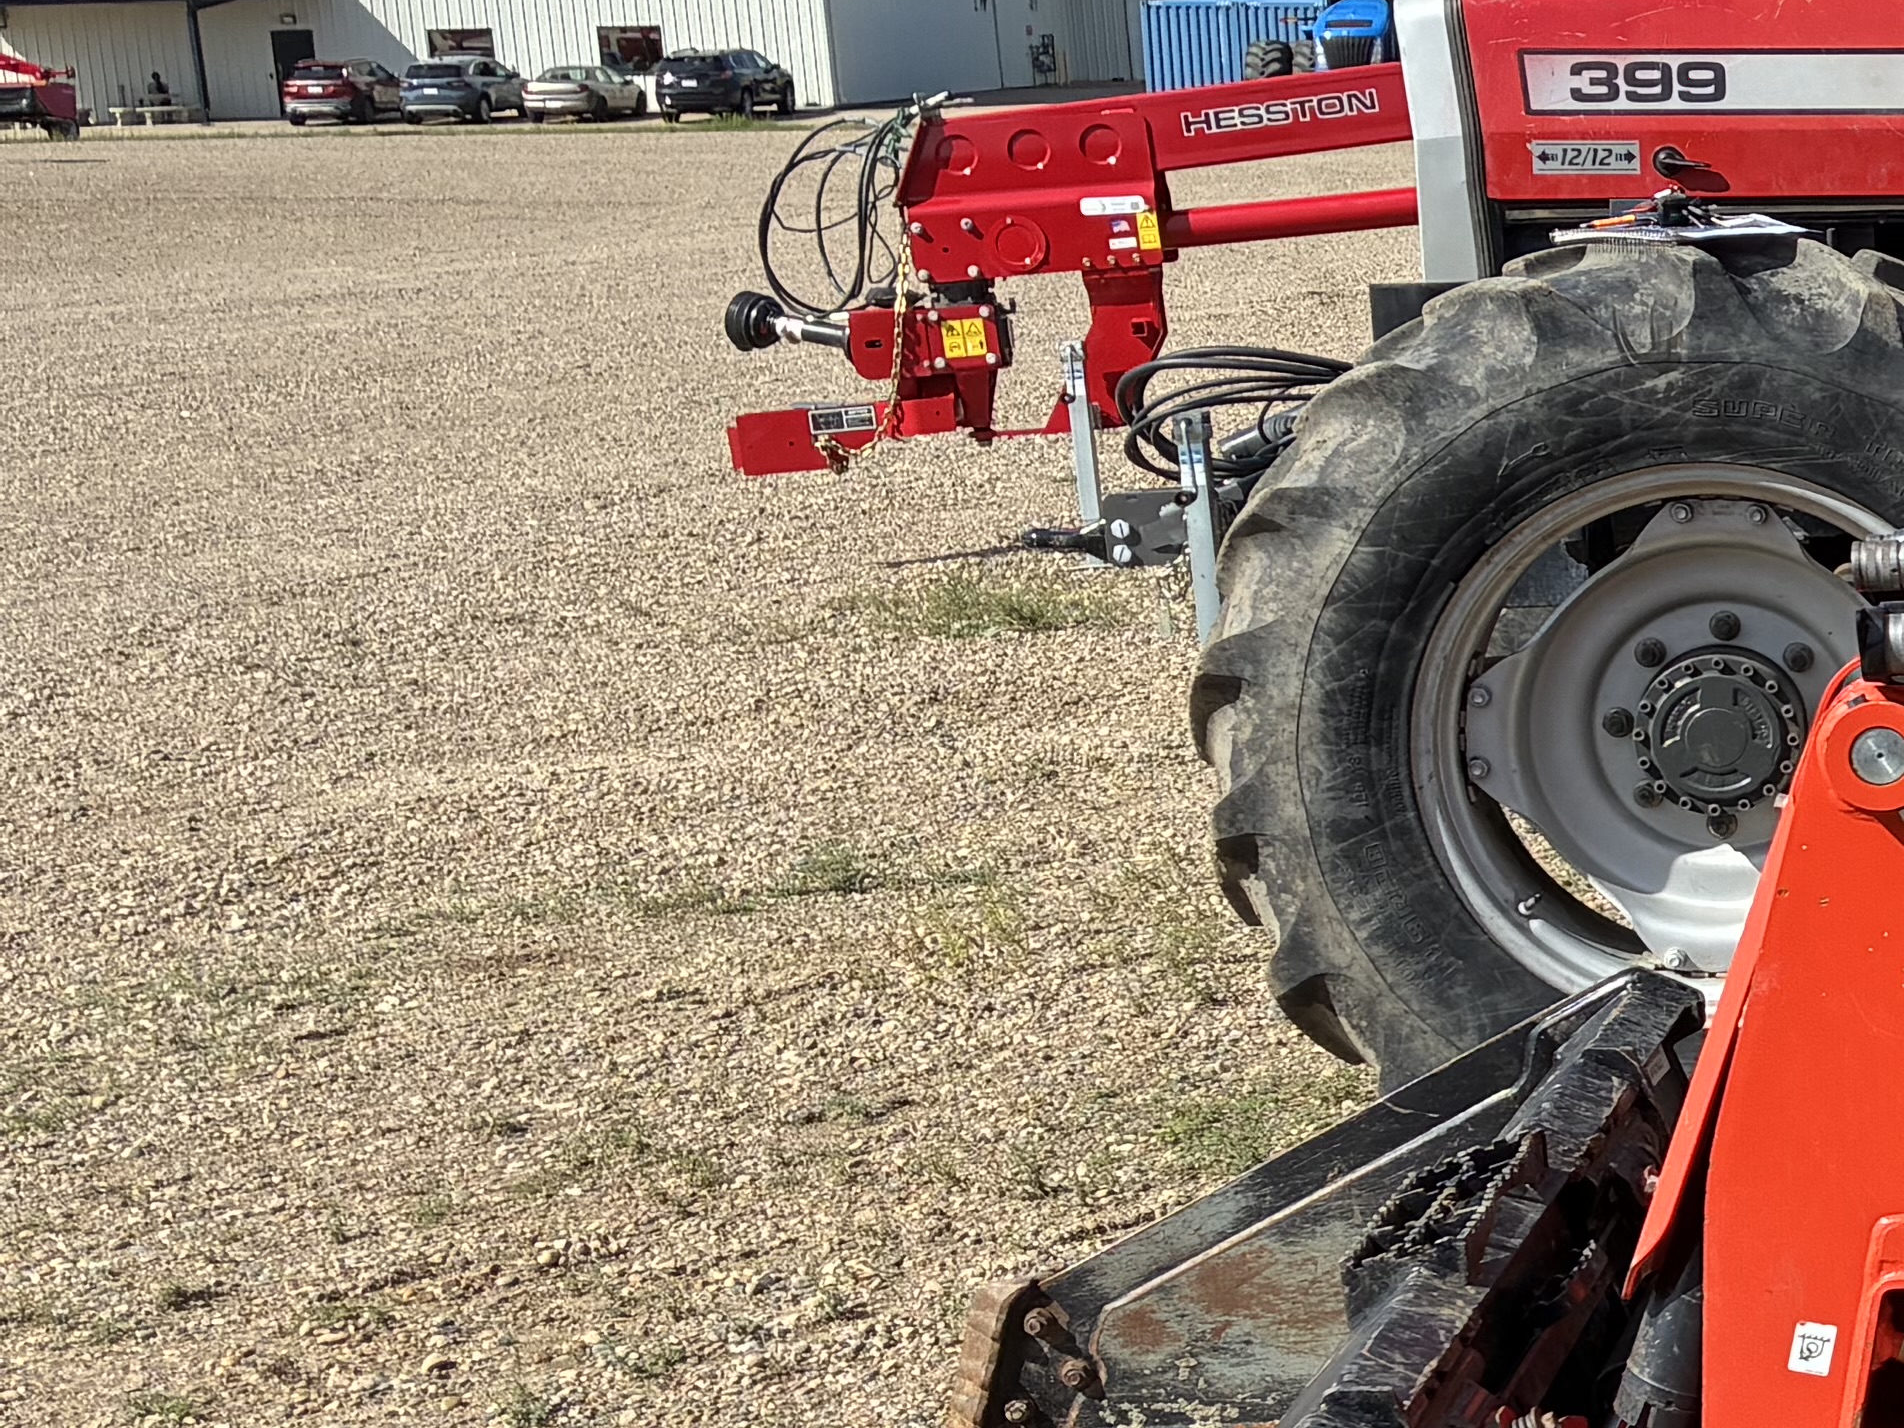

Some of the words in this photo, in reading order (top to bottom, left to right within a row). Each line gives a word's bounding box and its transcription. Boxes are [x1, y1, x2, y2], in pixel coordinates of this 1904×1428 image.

[1569, 61, 1726, 103] 399
[1181, 88, 1379, 137] HESSTON
[1560, 147, 1613, 167] 12/12
